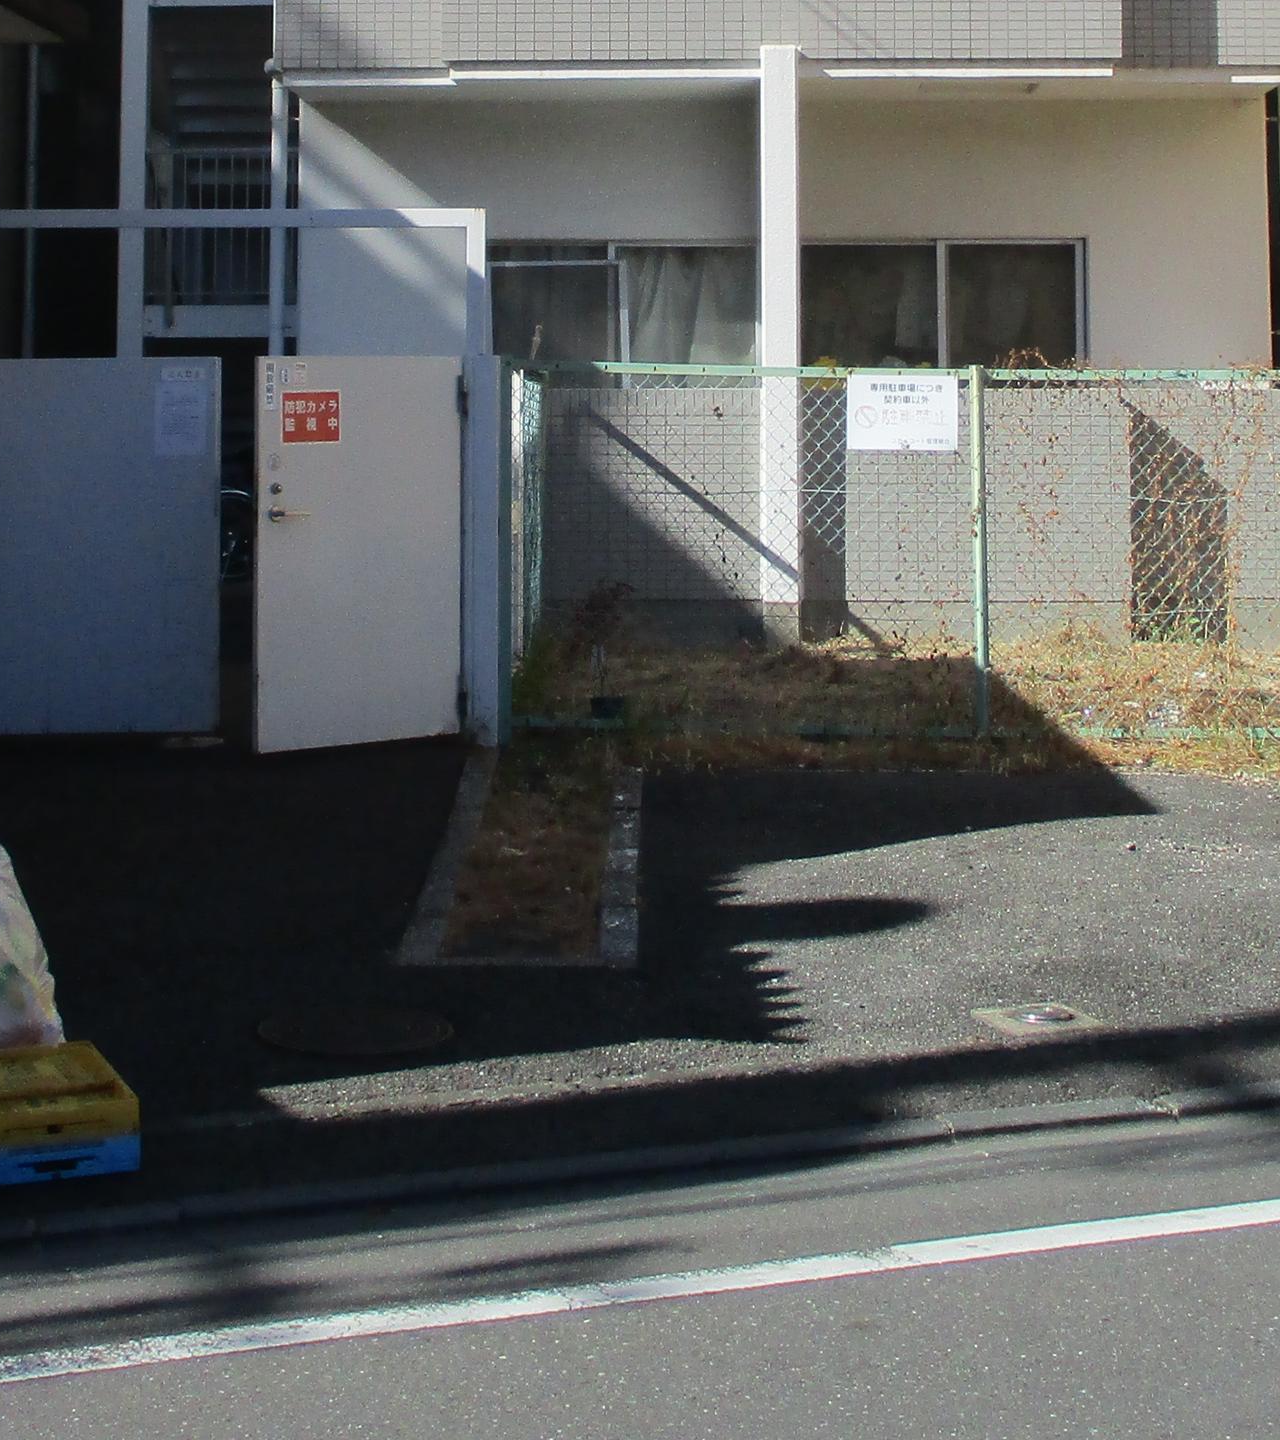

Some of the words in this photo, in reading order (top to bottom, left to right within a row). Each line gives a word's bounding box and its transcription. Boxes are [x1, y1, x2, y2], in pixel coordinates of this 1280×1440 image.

[870, 383, 943, 393] 専用駐車場につき
[883, 394, 929, 404] 契約車以外
[285, 400, 337, 414] 防犯カメラ
